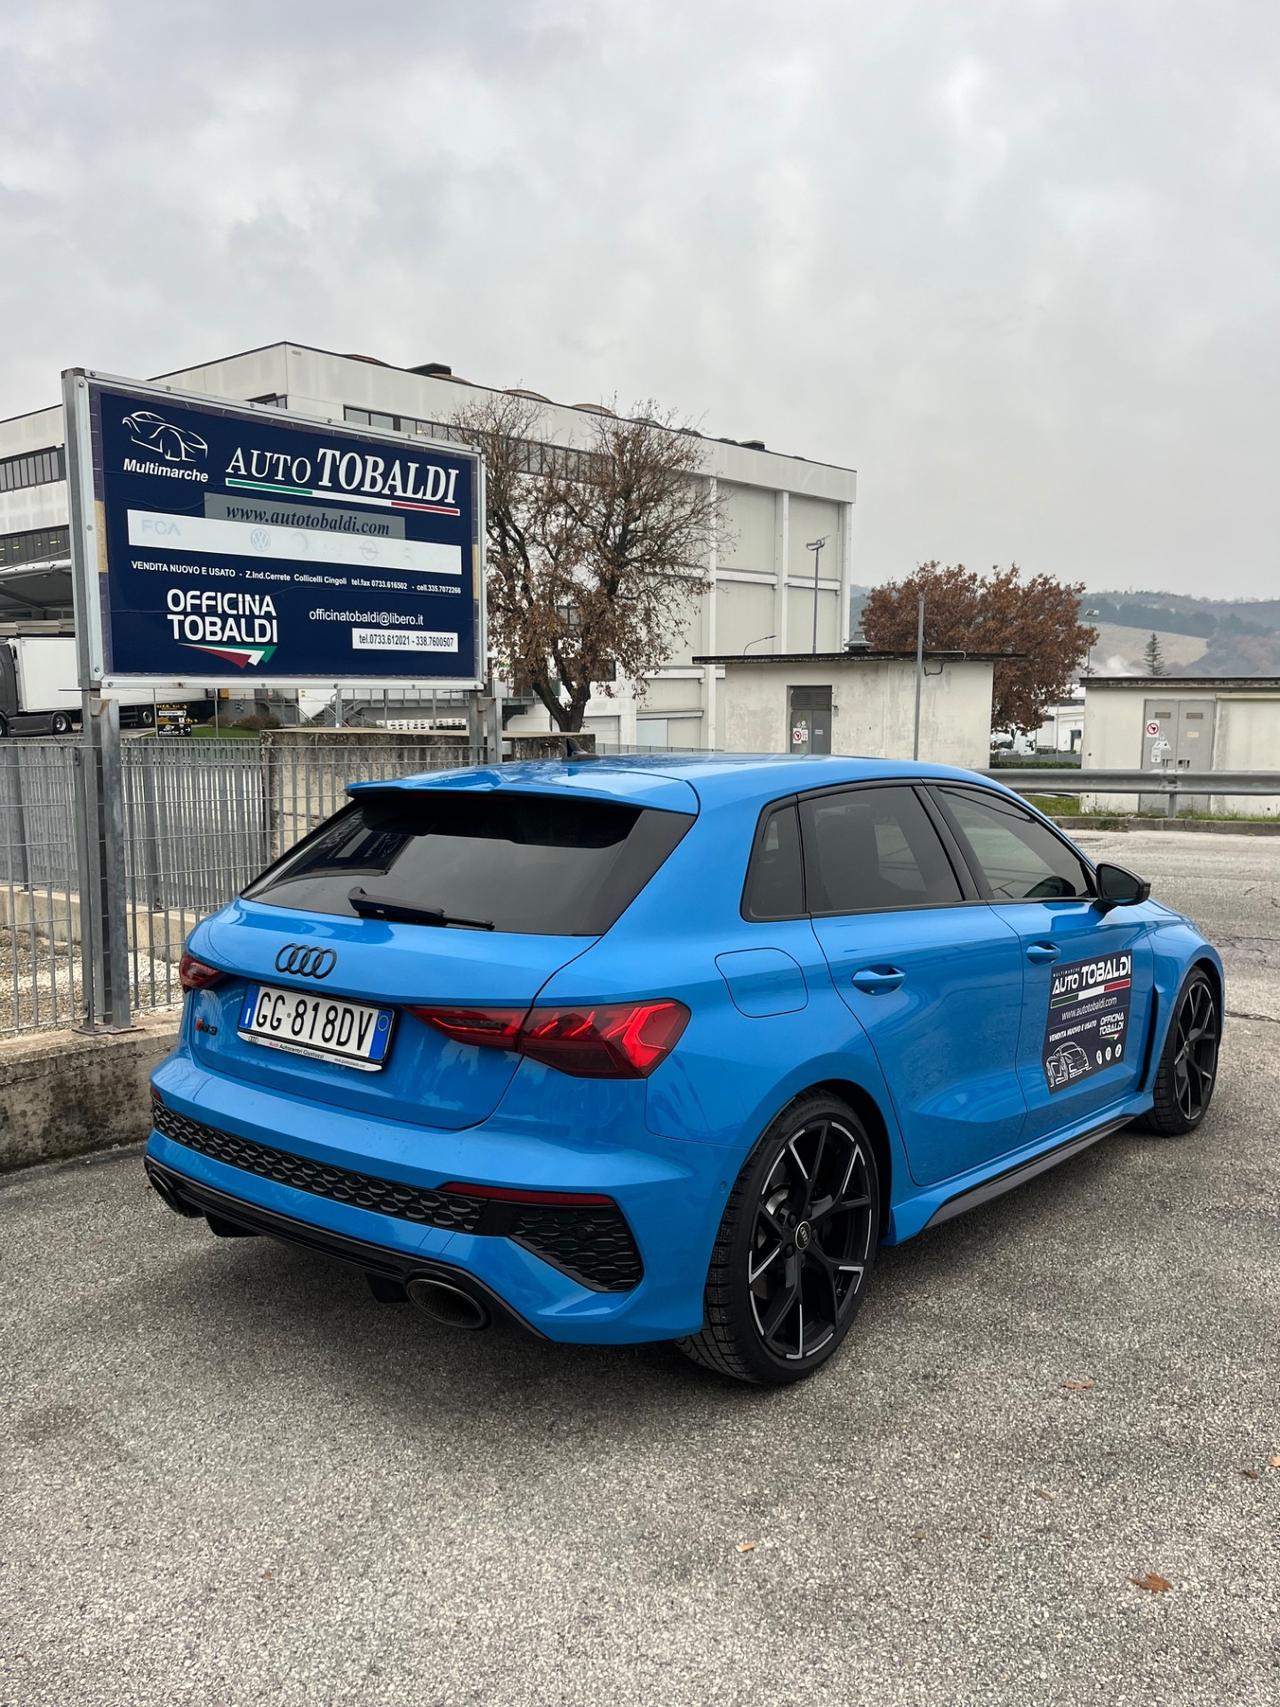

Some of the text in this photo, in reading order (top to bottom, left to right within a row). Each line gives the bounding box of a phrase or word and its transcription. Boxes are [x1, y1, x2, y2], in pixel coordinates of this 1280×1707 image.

[123, 458, 209, 483] Multimarche
[225, 447, 459, 504] AUTO TOBALDI
[226, 505, 390, 536] www.autotobaldi.com
[131, 560, 169, 573] VENDITA
[170, 564, 200, 575] NUOVO
[202, 567, 207, 575] E
[209, 567, 236, 578] USATO
[293, 573, 322, 583] Collicelli
[324, 575, 347, 586] Cingoli
[166, 588, 277, 616] OFFICINA
[167, 613, 278, 643] TOBALDI
[309, 608, 424, 627] officinatobaldi@libero.it
[359, 633, 410, 646] tel.0733.612021
[416, 636, 454, 648] 338.7600507
[1052, 955, 1131, 995] AUTO TOBALDI
[1062, 996, 1117, 1020] www.autotobaldi.com
[1100, 1011, 1125, 1025] OFFICINA
[1099, 1021, 1124, 1036] TOBALDI
